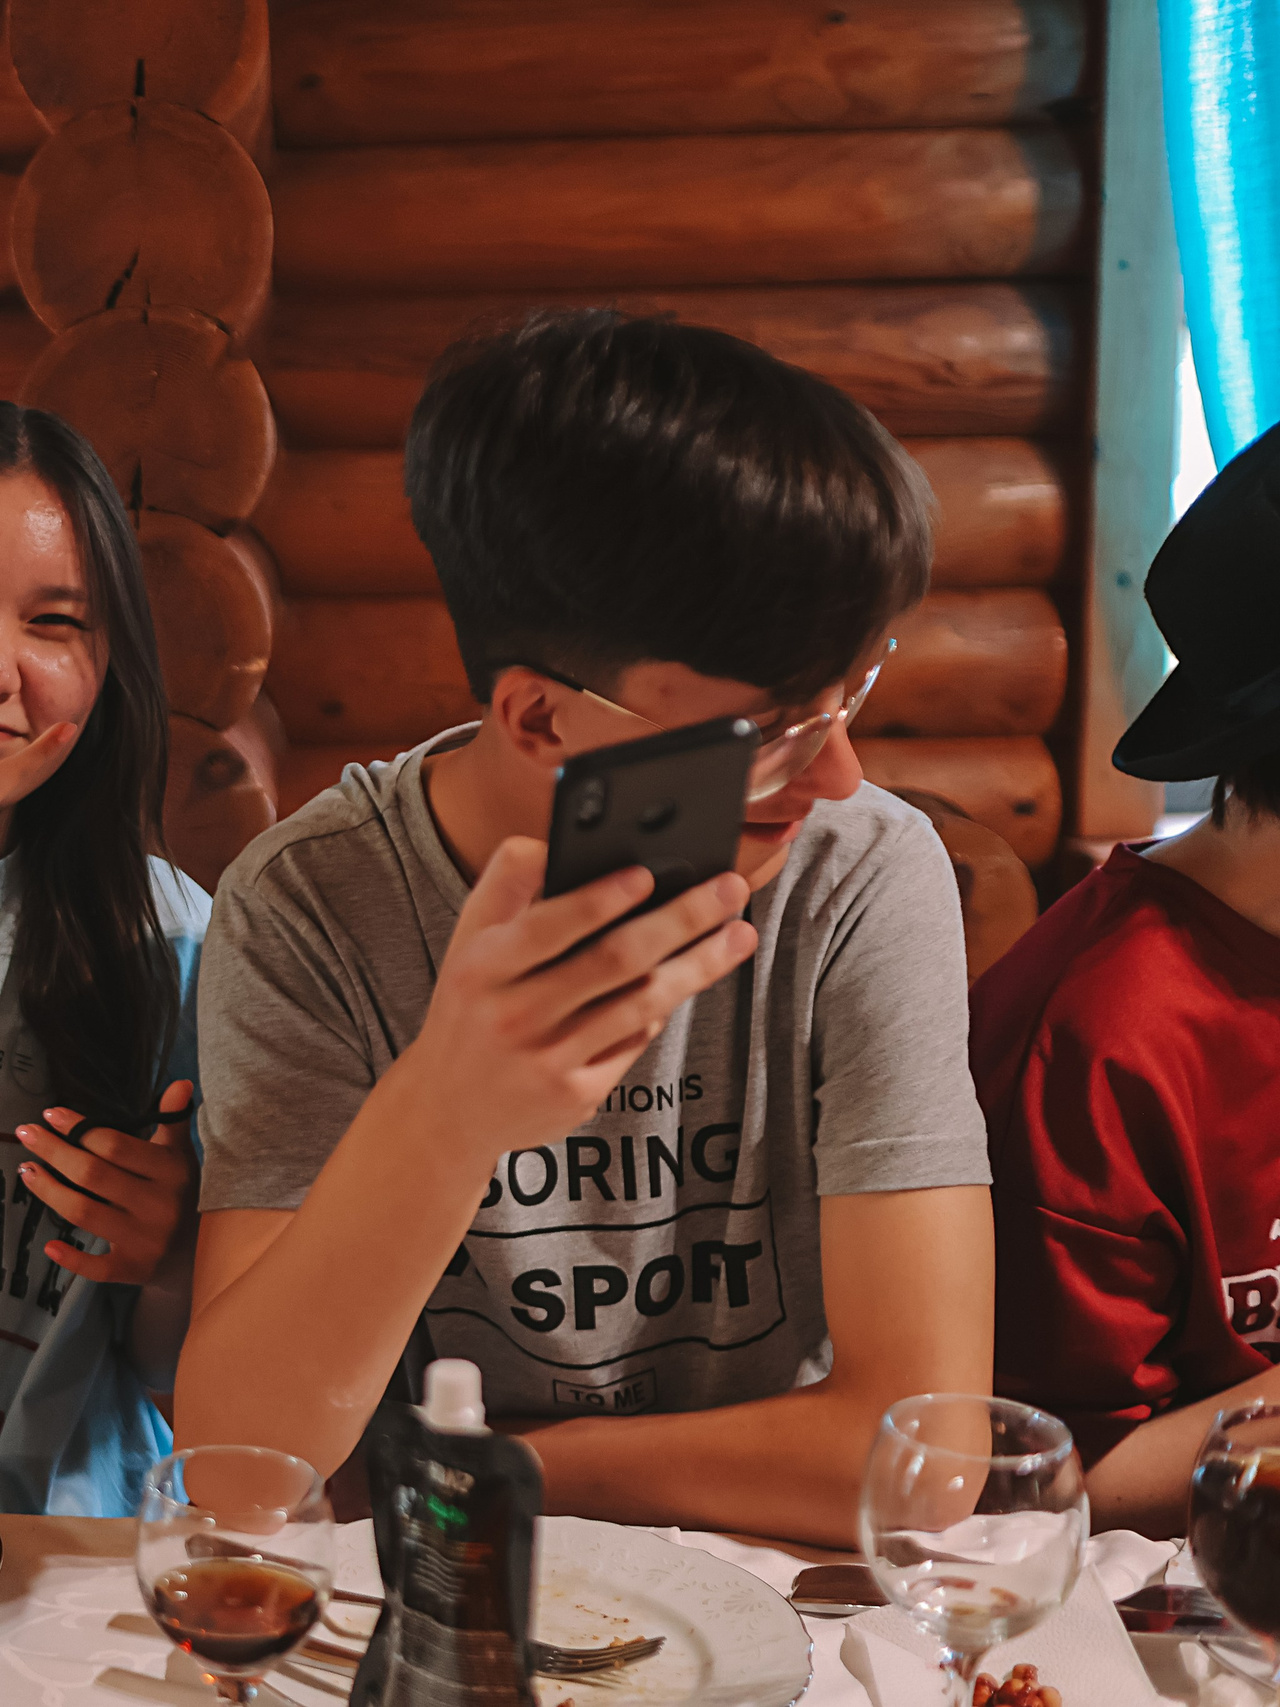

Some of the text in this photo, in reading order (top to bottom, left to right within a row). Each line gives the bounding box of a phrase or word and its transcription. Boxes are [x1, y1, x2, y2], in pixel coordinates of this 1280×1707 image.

[598, 1073, 705, 1113] TION IS
[510, 1239, 763, 1334] SPORT
[569, 1380, 646, 1410] TO ME
